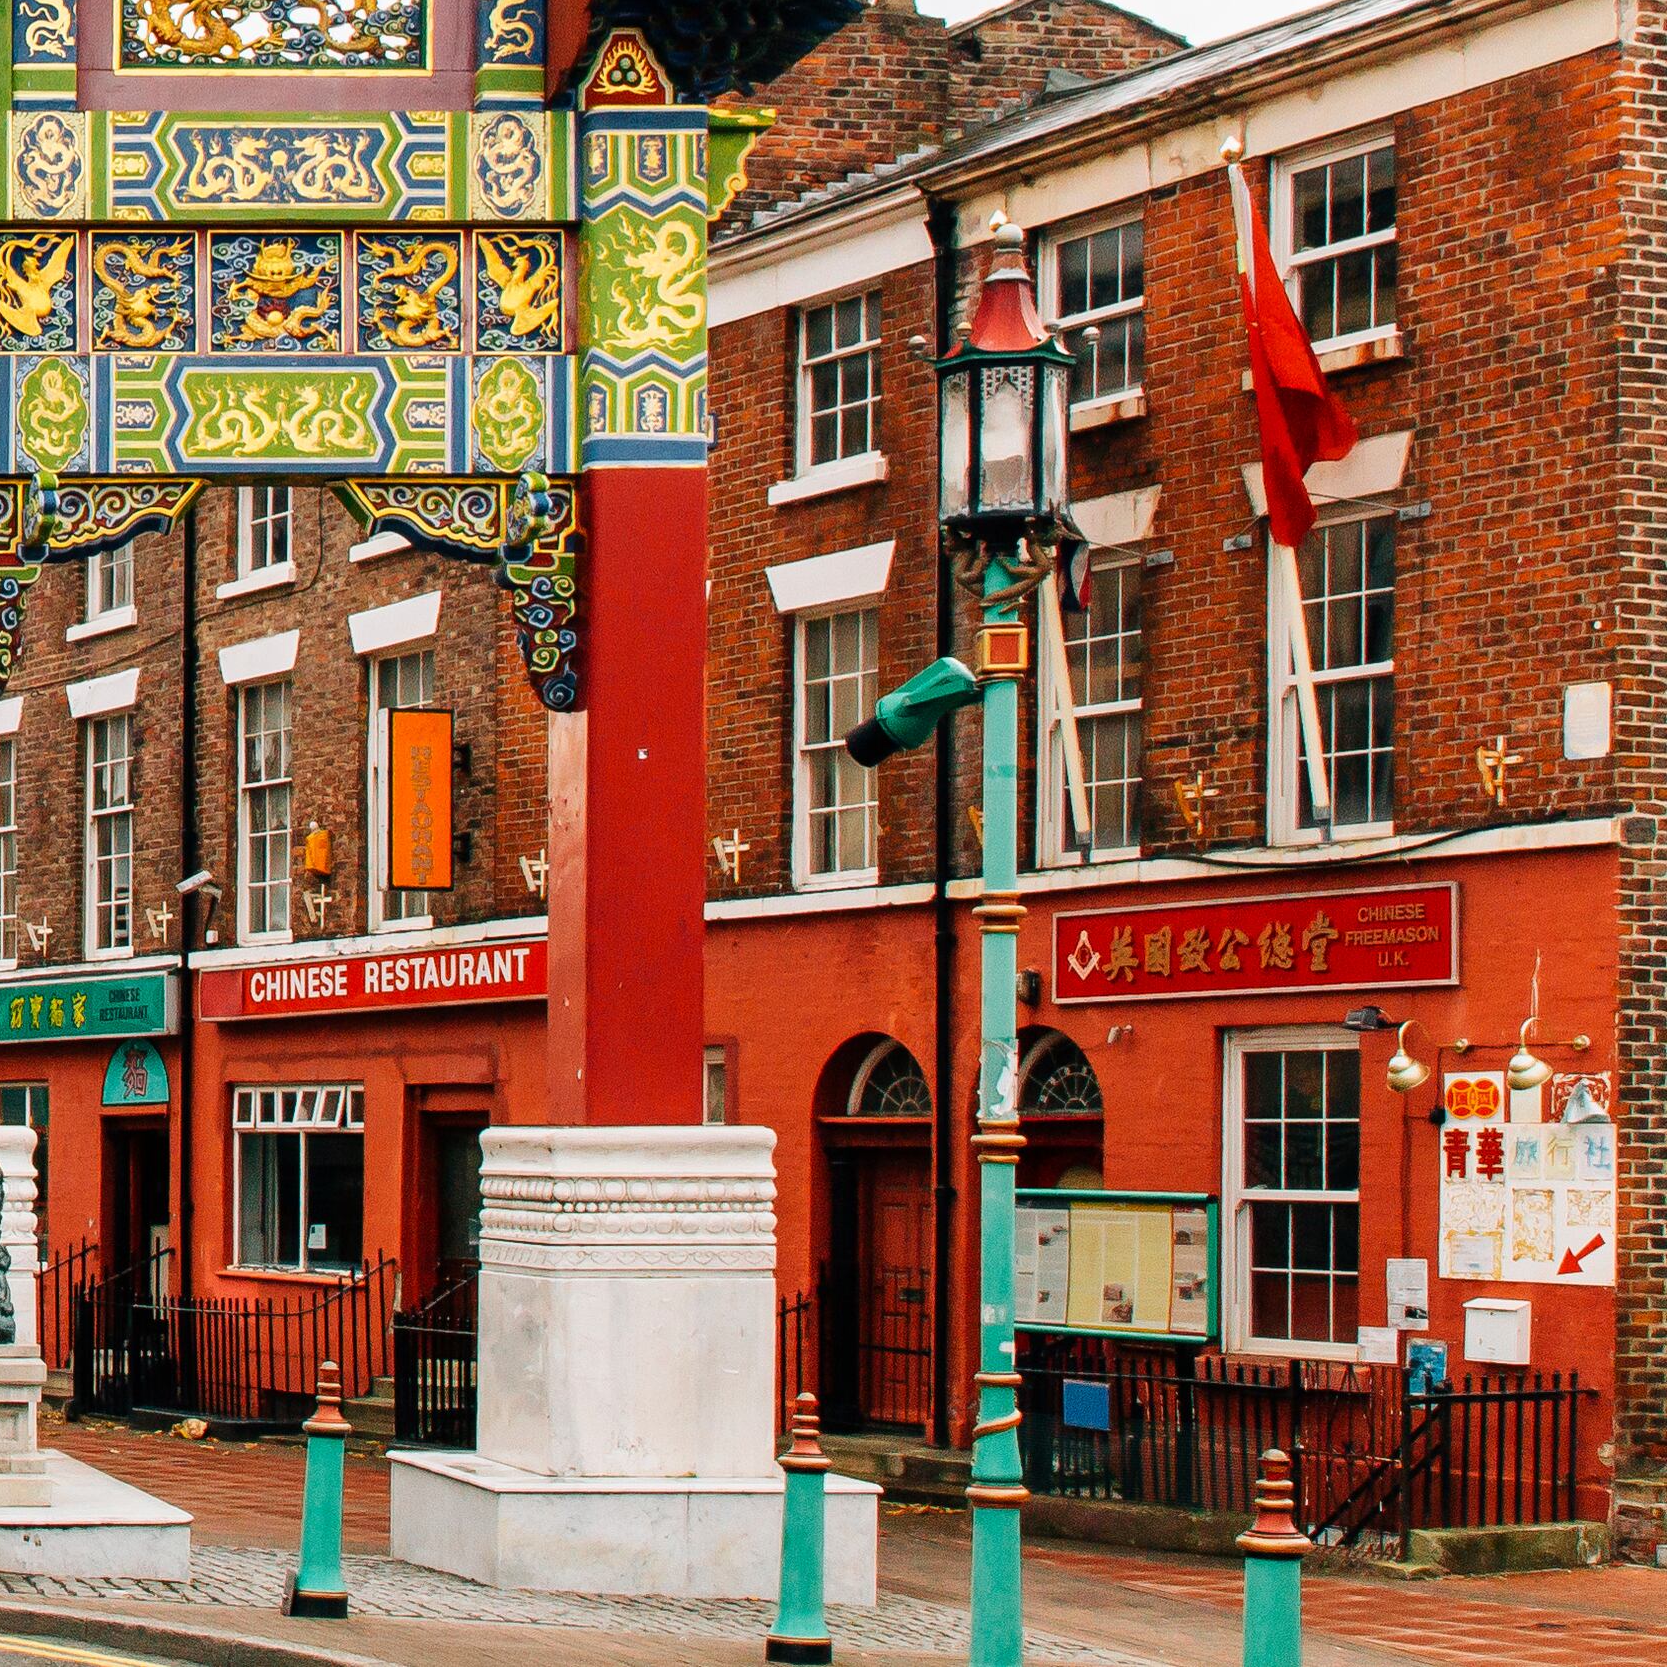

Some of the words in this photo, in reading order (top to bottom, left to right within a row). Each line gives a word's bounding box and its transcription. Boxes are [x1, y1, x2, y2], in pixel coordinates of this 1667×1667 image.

[1356, 903, 1426, 924] CHINESE
[1344, 925, 1441, 947] FREEMASON
[1377, 950, 1410, 968] U.K.
[249, 962, 349, 1004] CHINESE
[364, 947, 530, 994] RESTAURANT
[108, 987, 141, 1003] CHINESE
[99, 1004, 149, 1022] RESTAURANT
